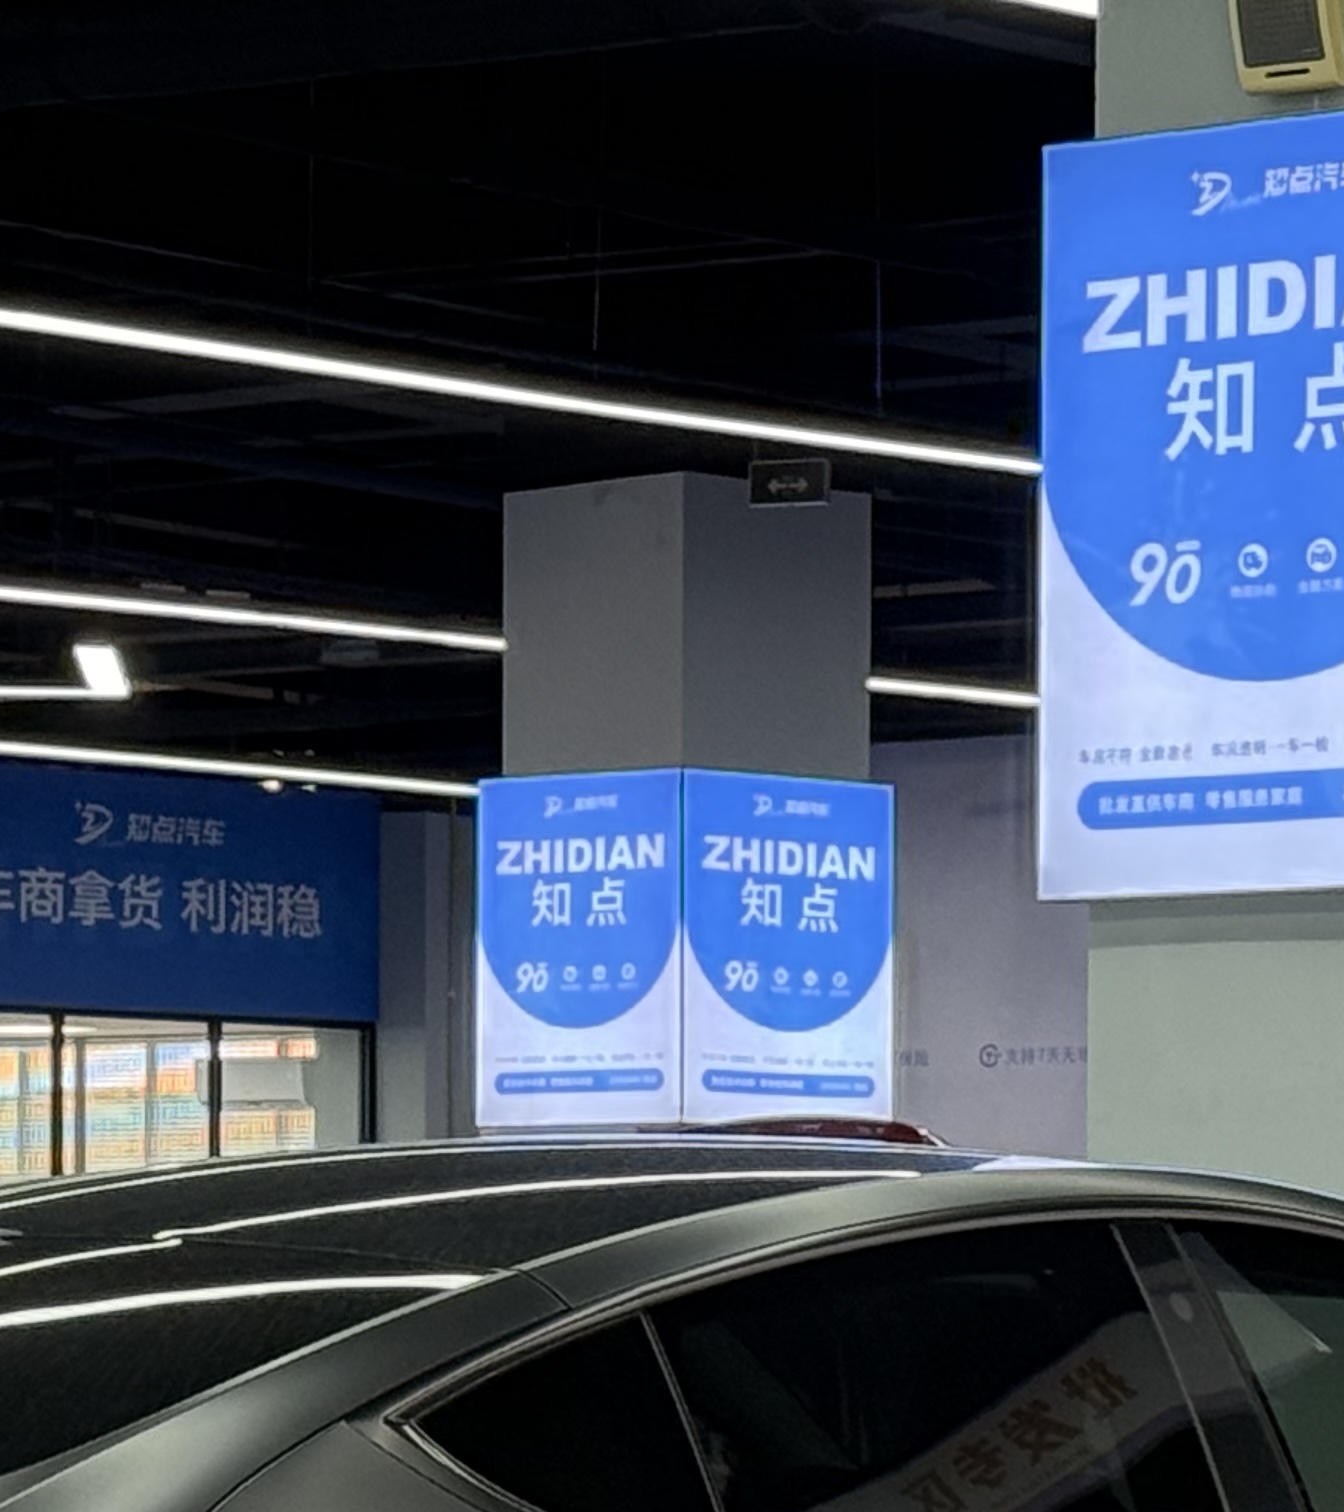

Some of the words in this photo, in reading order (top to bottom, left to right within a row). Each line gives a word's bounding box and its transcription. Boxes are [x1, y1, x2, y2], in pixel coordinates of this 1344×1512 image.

[495, 833, 666, 876] ZHIDIAN
[701, 834, 876, 881] ZHIDIAN
[181, 877, 323, 939] 利润稳
[531, 876, 627, 927] 知点
[740, 877, 839, 933] 知点
